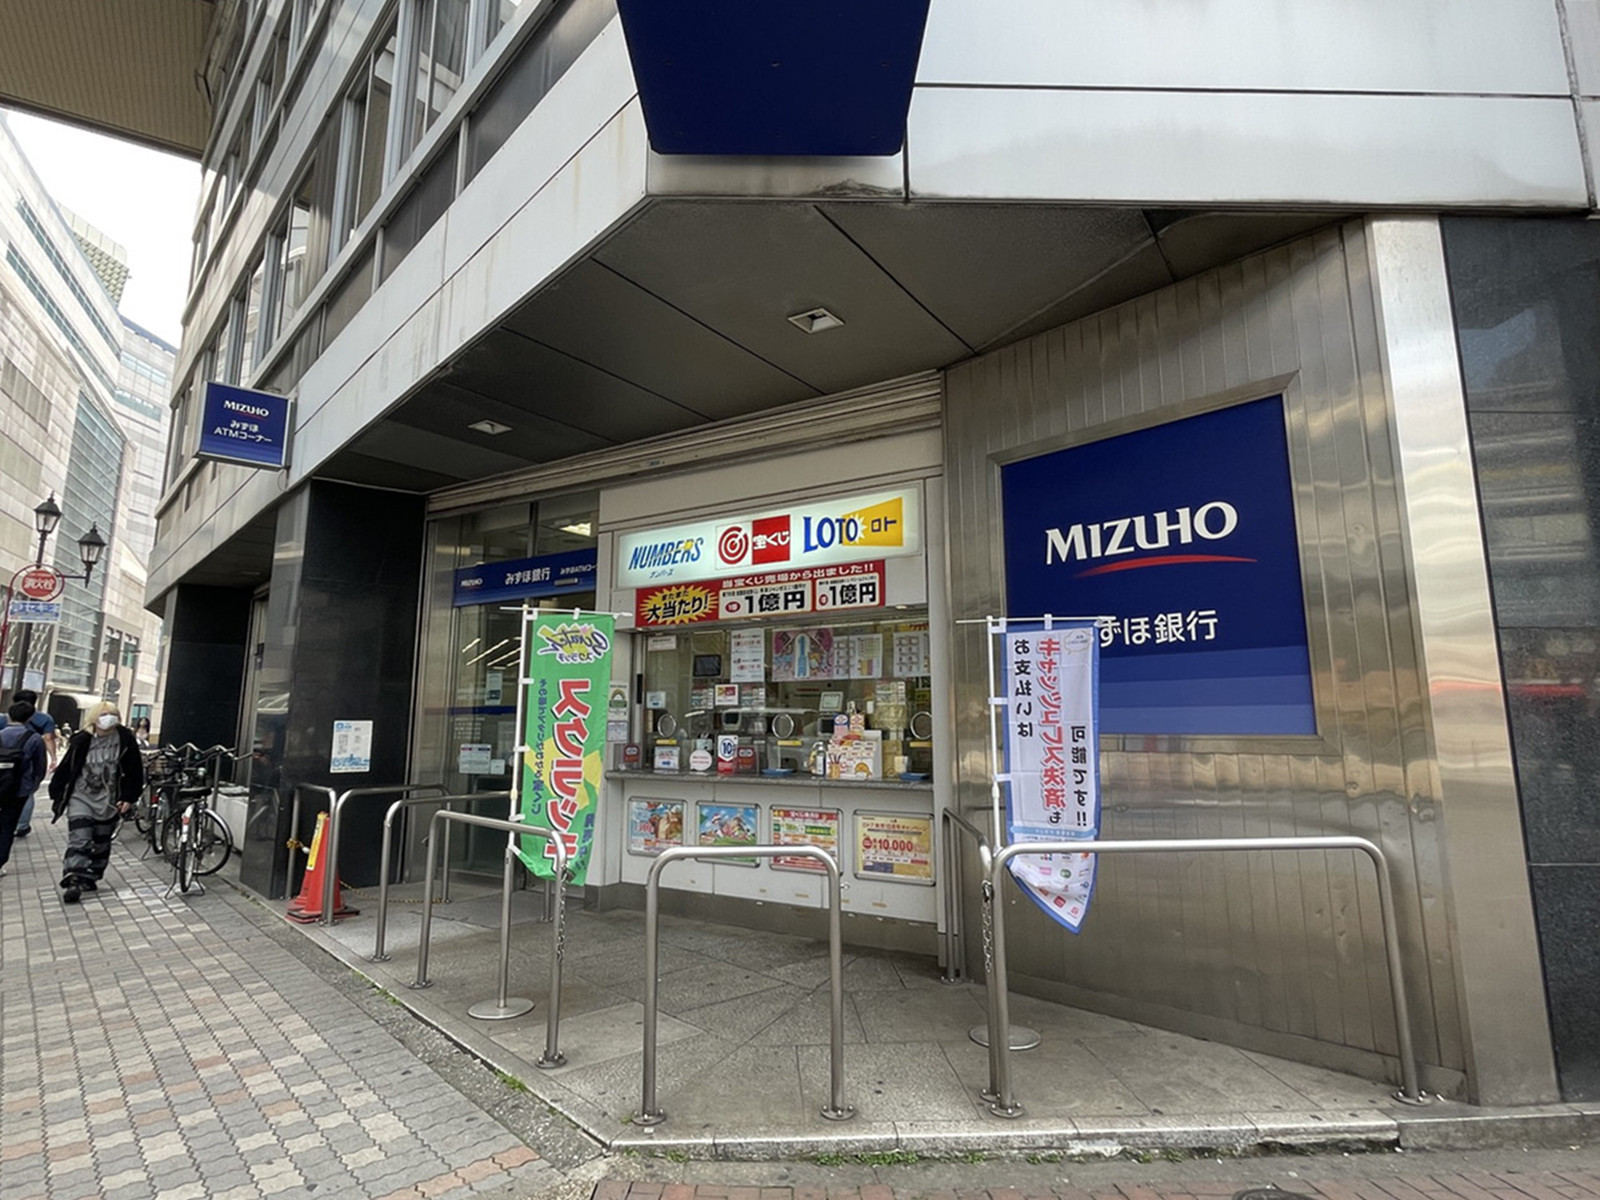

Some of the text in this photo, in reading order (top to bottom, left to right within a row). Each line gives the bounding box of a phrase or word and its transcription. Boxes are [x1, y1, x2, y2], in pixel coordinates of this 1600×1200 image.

[223, 400, 270, 417] MIZUHO
[213, 426, 273, 443] ATMコーナー
[229, 419, 259, 433] みずほ
[802, 515, 859, 553] LOTO
[871, 516, 898, 533] ロト
[1045, 501, 1238, 565] MIZUHO
[752, 530, 791, 550] 宝くじ
[628, 537, 705, 570] NUMBERS
[24, 577, 55, 590] 消火栓
[504, 567, 551, 585] みずほ銀行
[745, 590, 805, 614] 1億円
[829, 582, 877, 606] 1億円
[648, 594, 708, 621] 大当たり!
[1100, 609, 1218, 648] ずほ銀行
